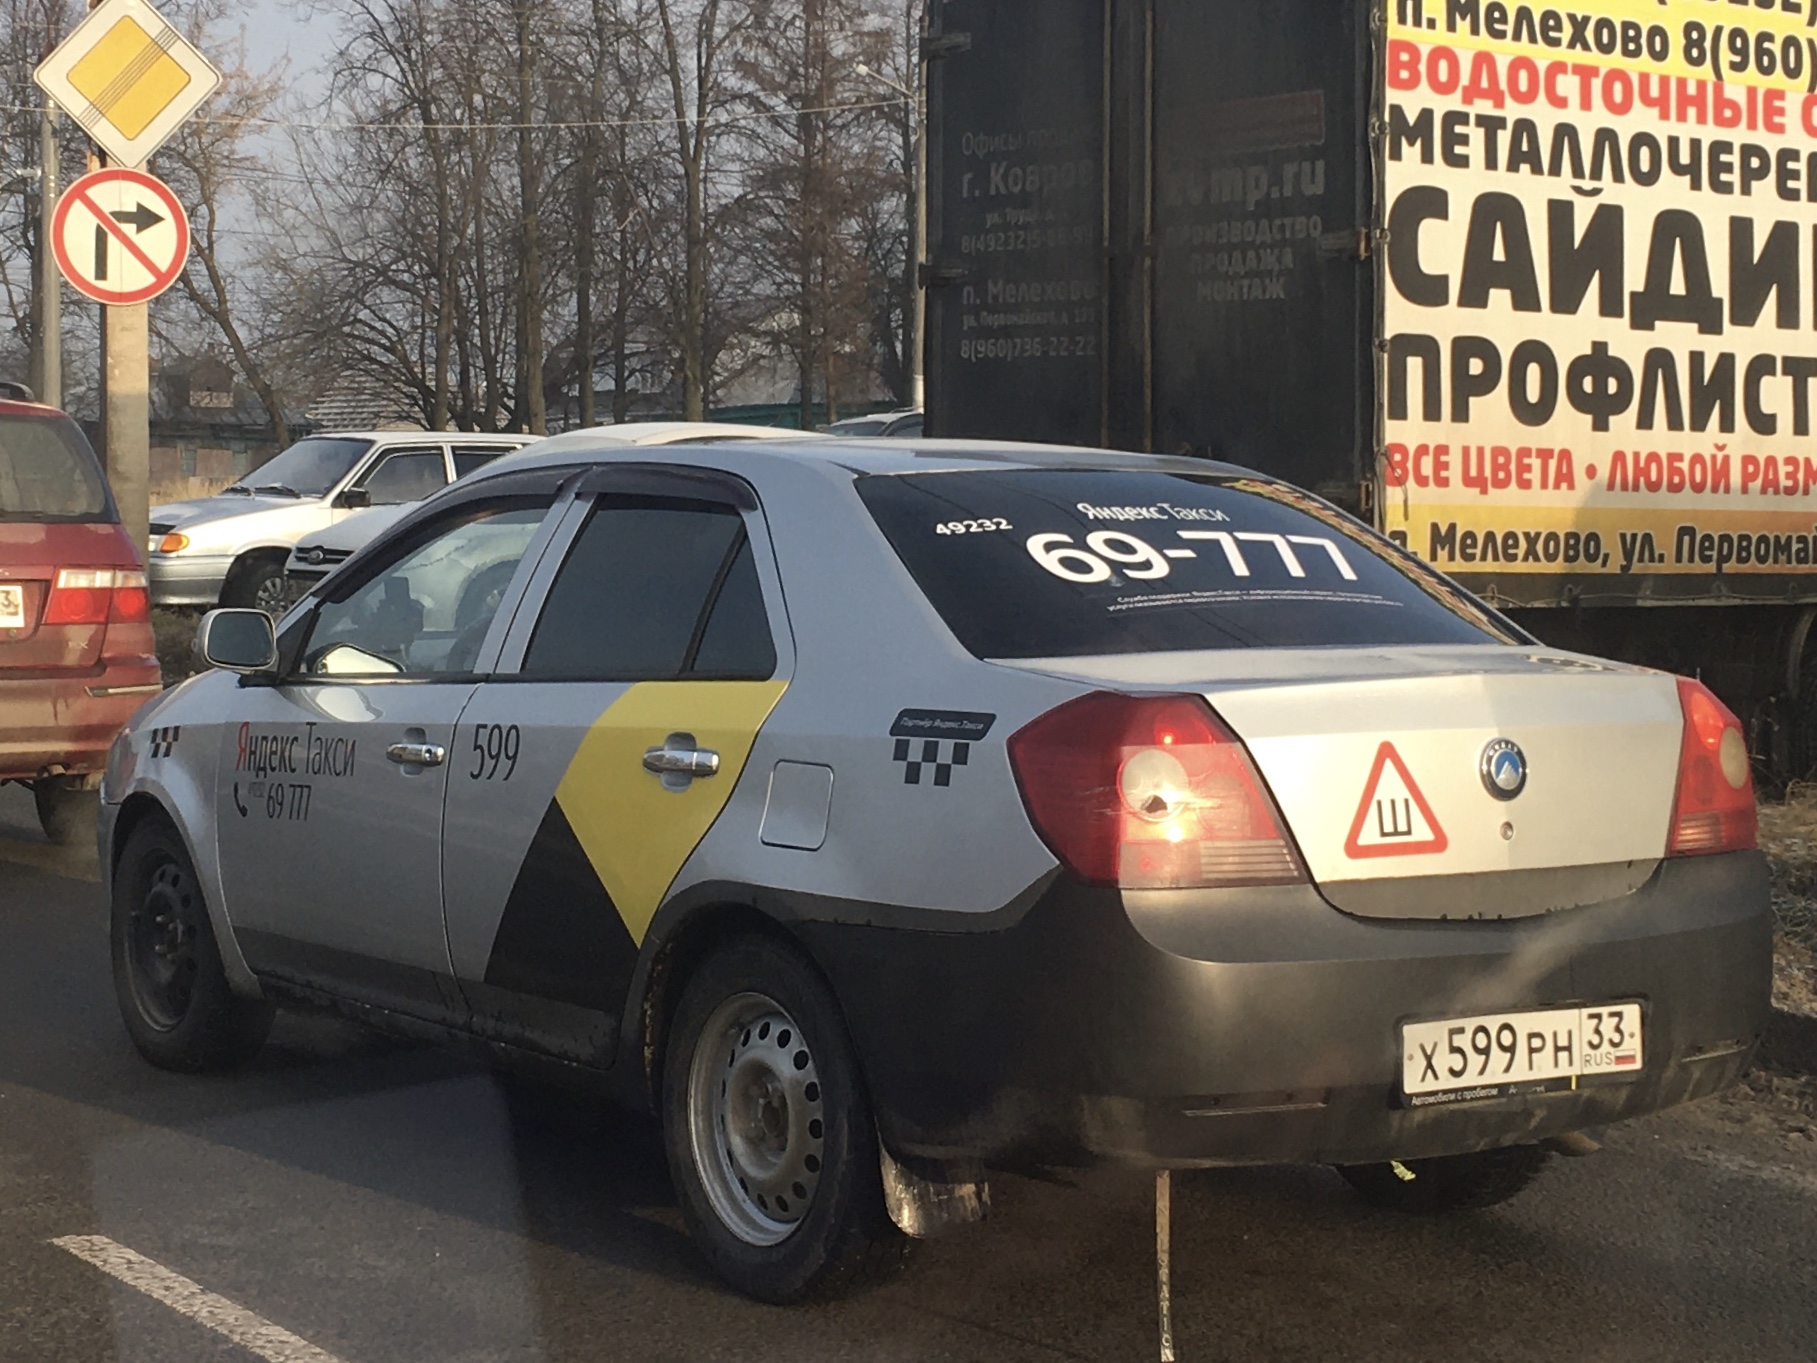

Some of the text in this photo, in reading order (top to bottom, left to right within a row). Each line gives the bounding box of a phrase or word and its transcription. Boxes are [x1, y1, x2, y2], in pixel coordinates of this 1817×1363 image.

[1445, 0, 1670, 63] Мелехово
[1387, 38, 1787, 135] ВОДОСТОЧНЫЕ
[1386, 184, 1817, 336] САЙДИ
[1197, 276, 1286, 301] МОНТАЖ
[960, 335, 1097, 362] 8(960)736-22-22
[1387, 332, 1817, 437] ПРОФЛИСТ
[1385, 442, 1450, 488] ВСЕ
[1461, 445, 1576, 495] ЦВЕТА
[1606, 443, 1731, 495] ЛЮБОЙ
[935, 517, 1014, 536] 49232
[1076, 502, 1231, 522] Яндекс Такси
[1025, 529, 1358, 583] 69-777
[1429, 521, 1611, 568] Мелехово,
[1619, 532, 1665, 574] ул.
[1674, 525, 1817, 576] Первома
[235, 721, 357, 779] Яндекс Такси
[468, 723, 521, 781] 599
[266, 782, 285, 821] 69
[288, 784, 313, 823] 777
[1376, 797, 1412, 838] Ш
[1419, 1010, 1625, 1084] Х599РН 33 RUS
